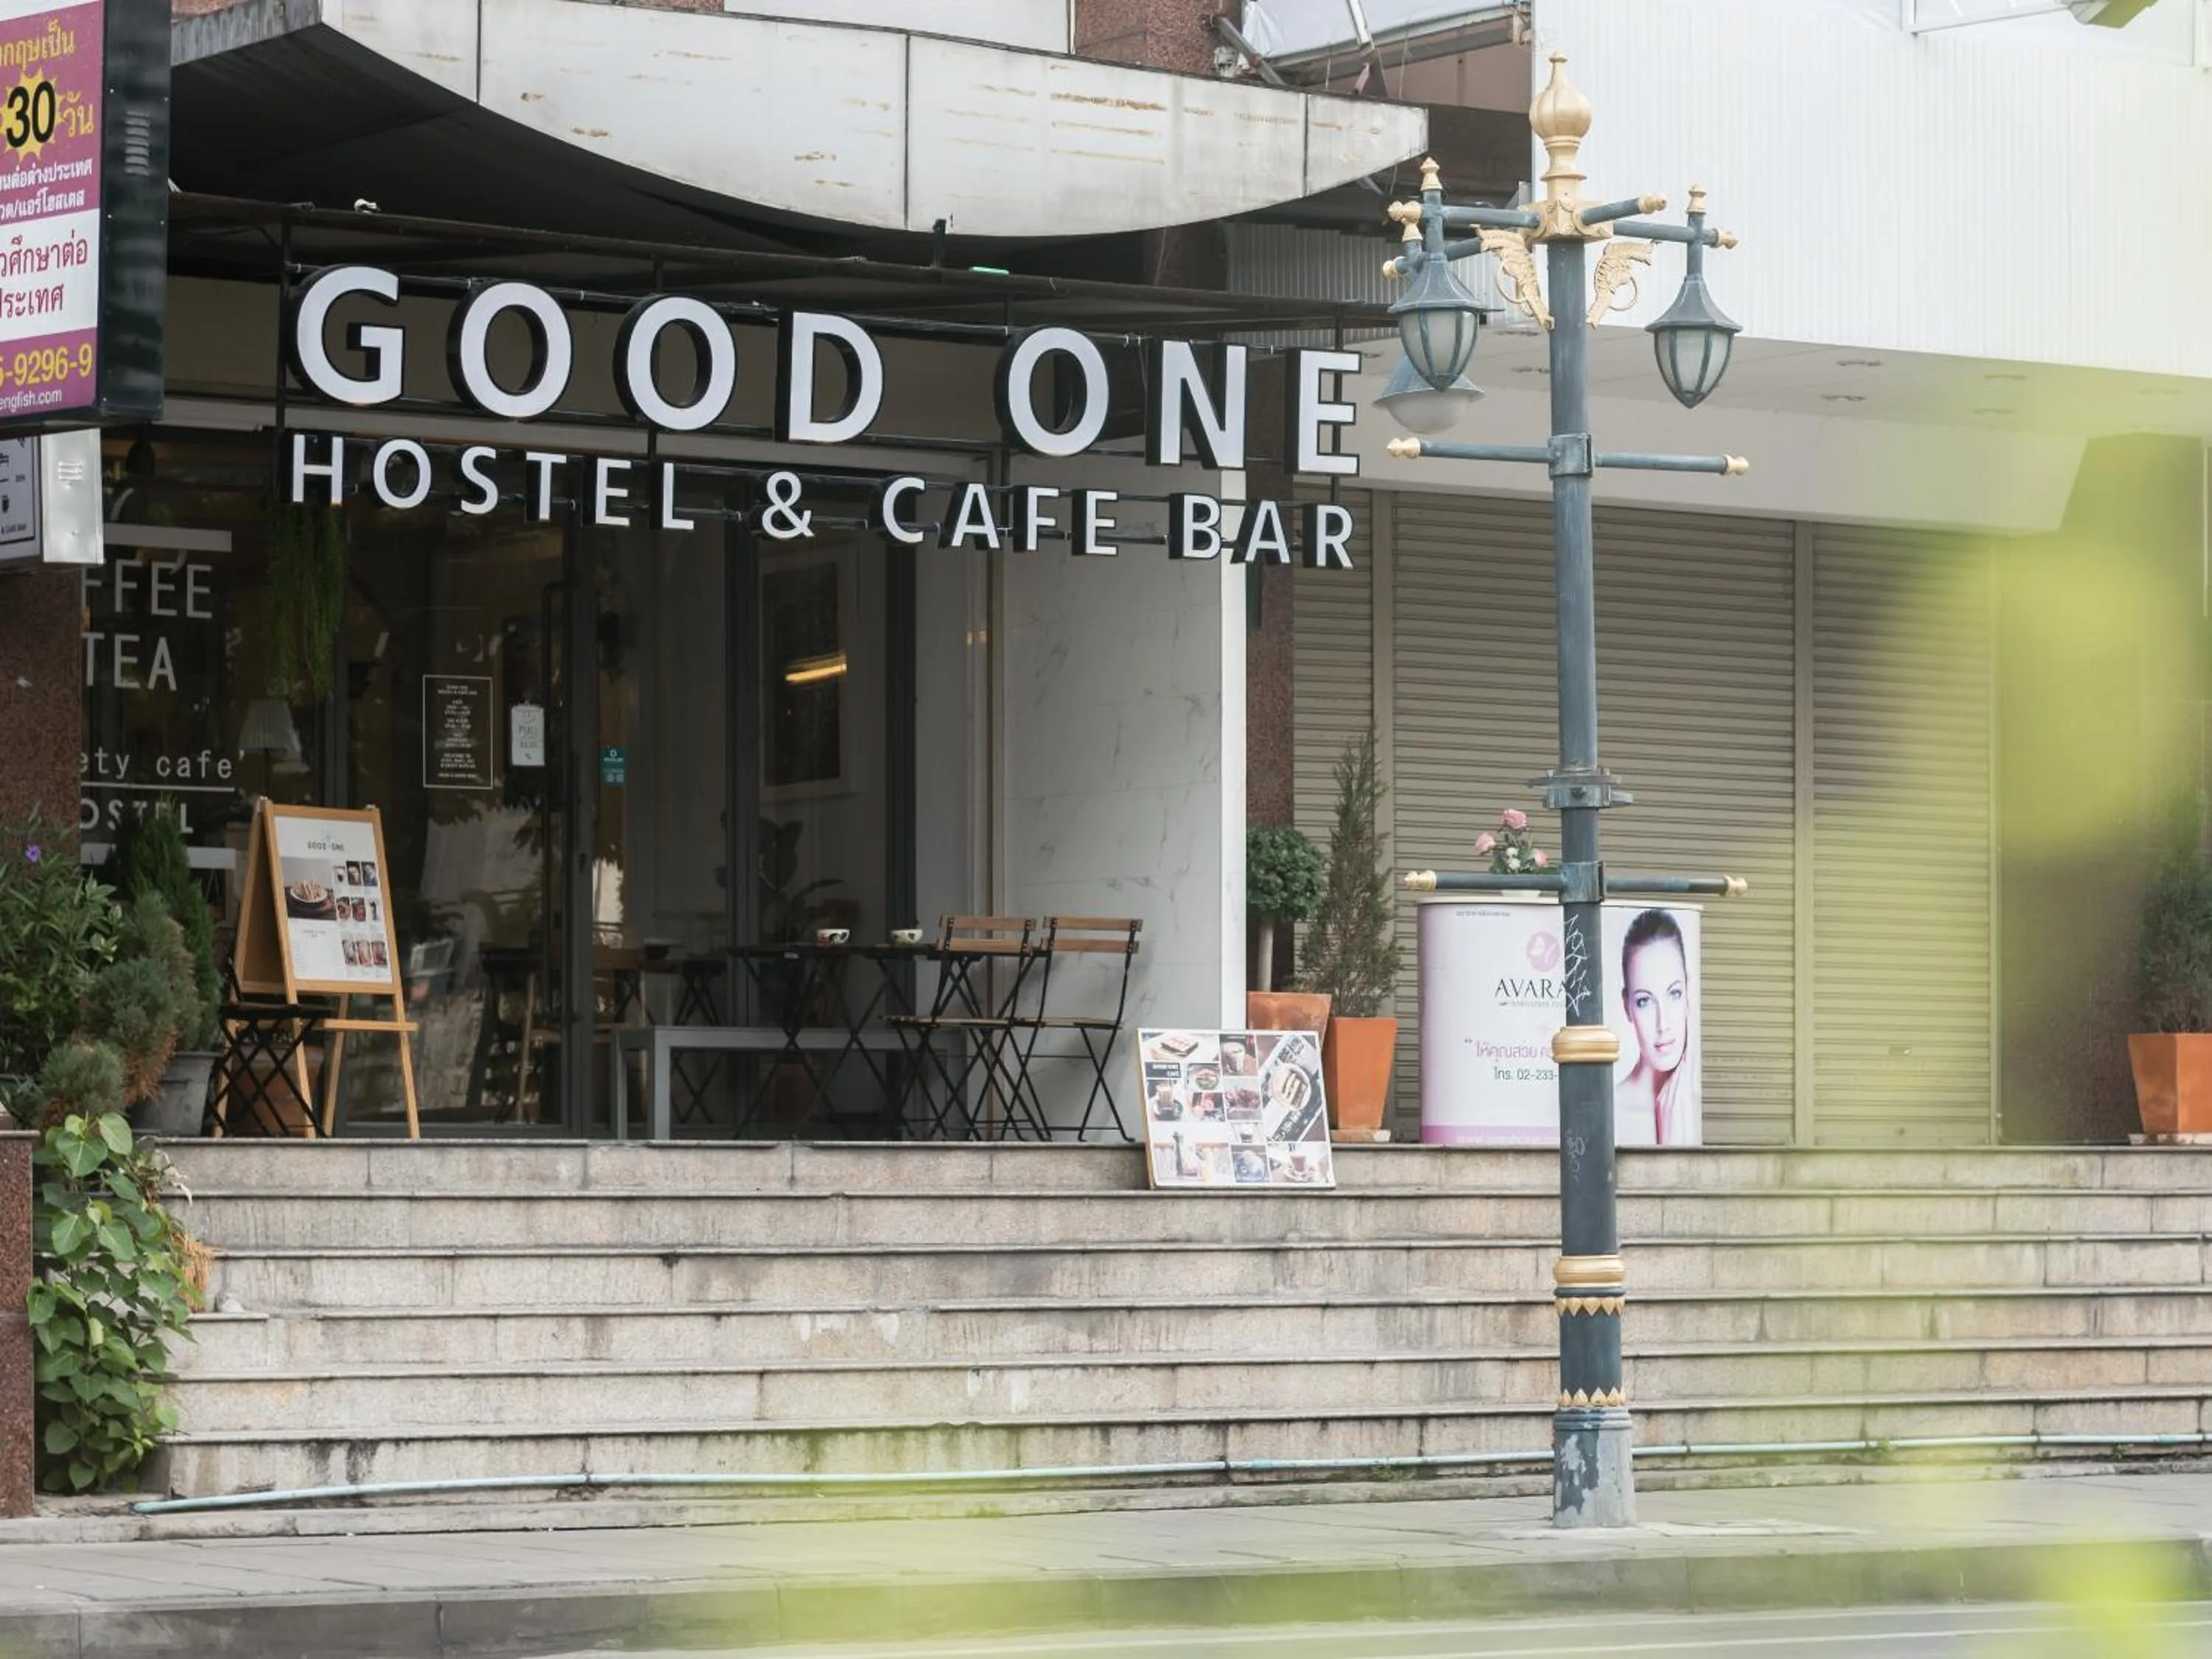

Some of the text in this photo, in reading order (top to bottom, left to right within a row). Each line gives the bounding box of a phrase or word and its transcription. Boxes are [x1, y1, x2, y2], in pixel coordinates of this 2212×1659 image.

[0, 19, 74, 71] กฤษเป็น
[6, 81, 56, 147] 30
[63, 91, 94, 138] วัน
[0, 283, 64, 319] ระเทศ
[296, 265, 1361, 476] GOOD ONE
[293, 434, 1354, 568] HOSTEL & CAFE BAR
[82, 632, 177, 691] TEA
